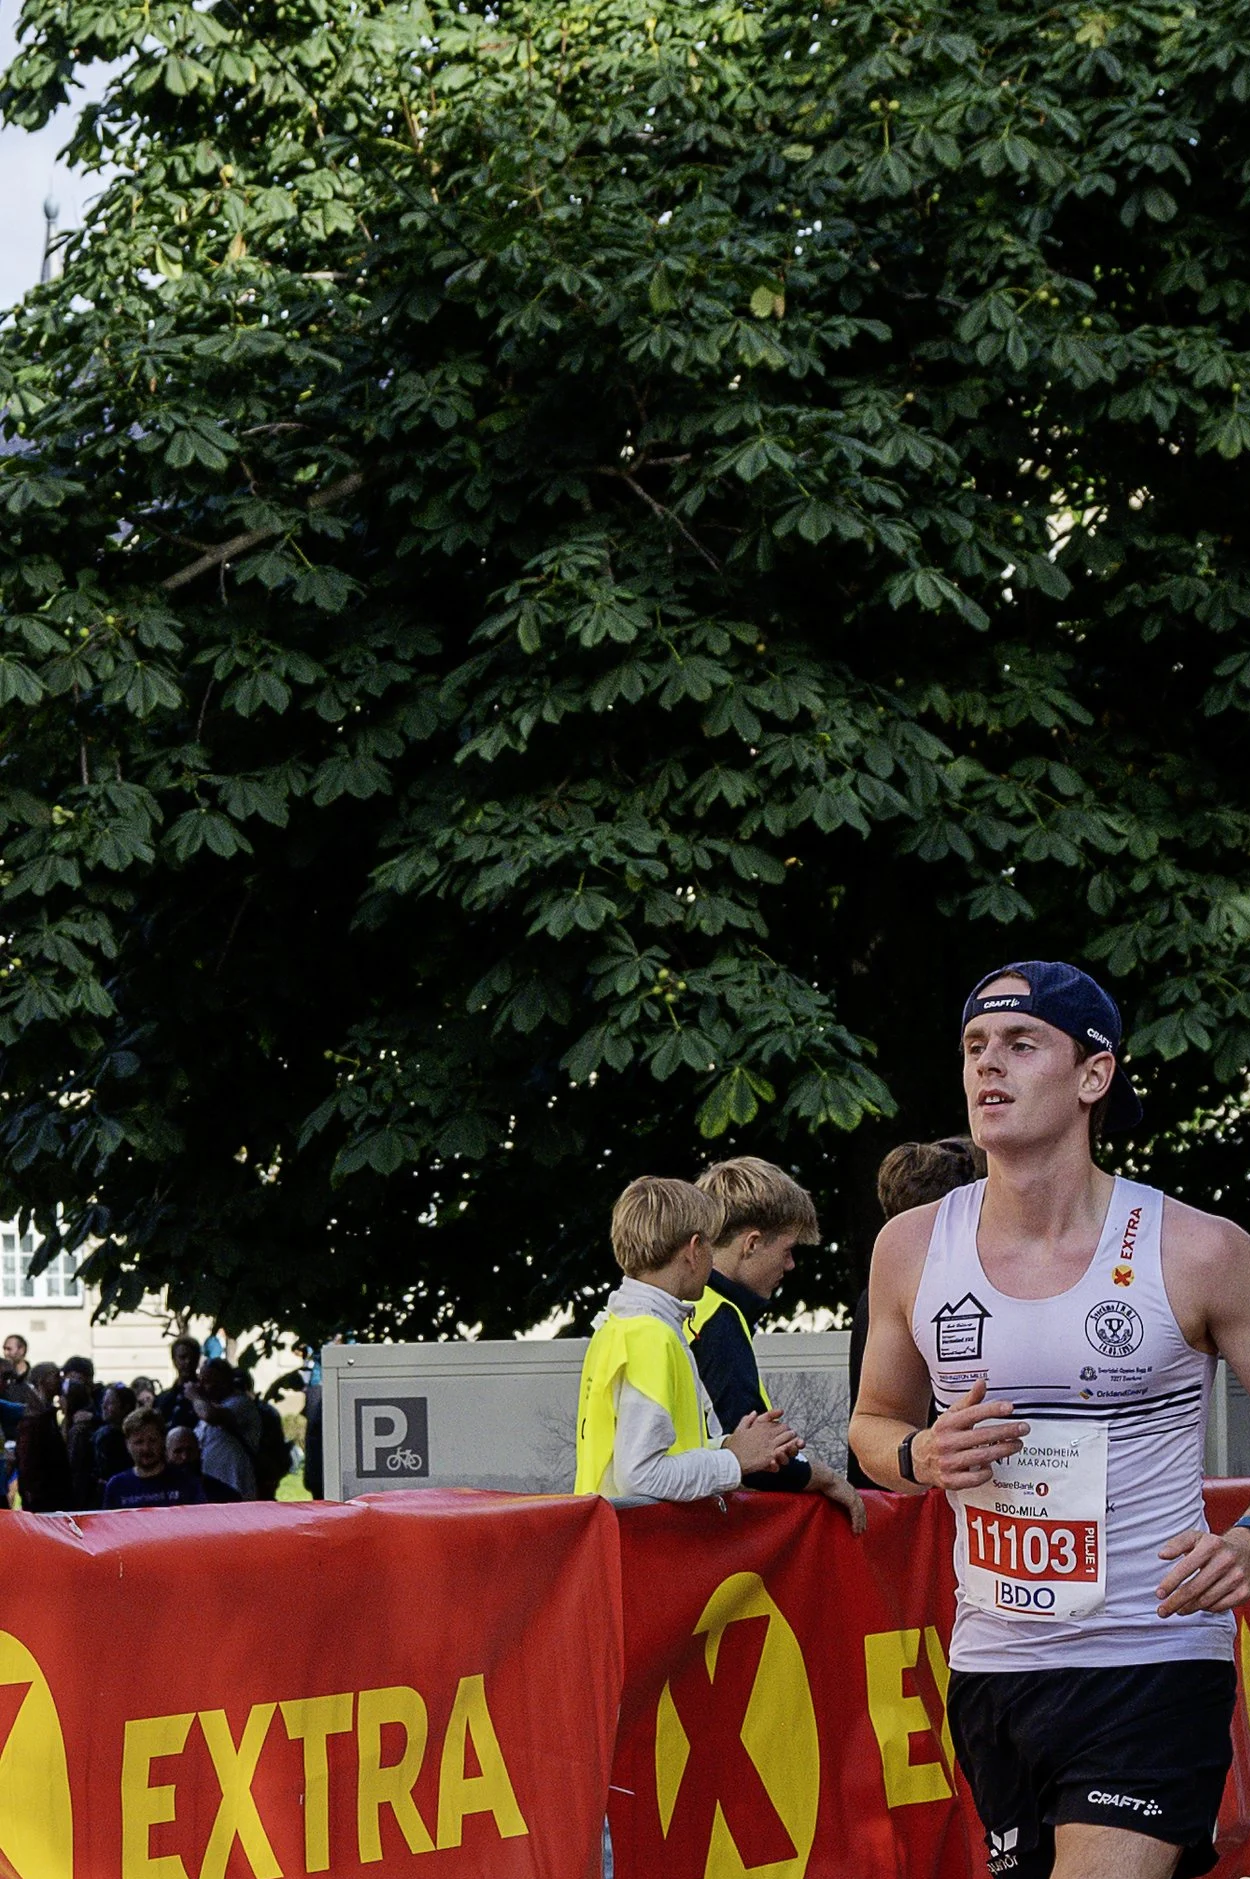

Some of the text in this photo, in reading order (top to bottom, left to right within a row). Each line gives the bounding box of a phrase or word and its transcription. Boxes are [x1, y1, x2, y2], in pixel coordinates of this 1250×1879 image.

[983, 999, 1011, 1009] CRAFT
[1086, 1028, 1110, 1050] CRAFT
[1120, 1207, 1142, 1260] EXTRA
[361, 1405, 407, 1471] P
[1017, 1458, 1069, 1469] MARATON
[994, 1502, 1049, 1517] BDO-MILA
[971, 1516, 1078, 1574] 11103
[1084, 1527, 1096, 1565] PULJE
[1001, 1581, 1056, 1609] BDO
[1087, 1790, 1147, 1811] CRAFT
